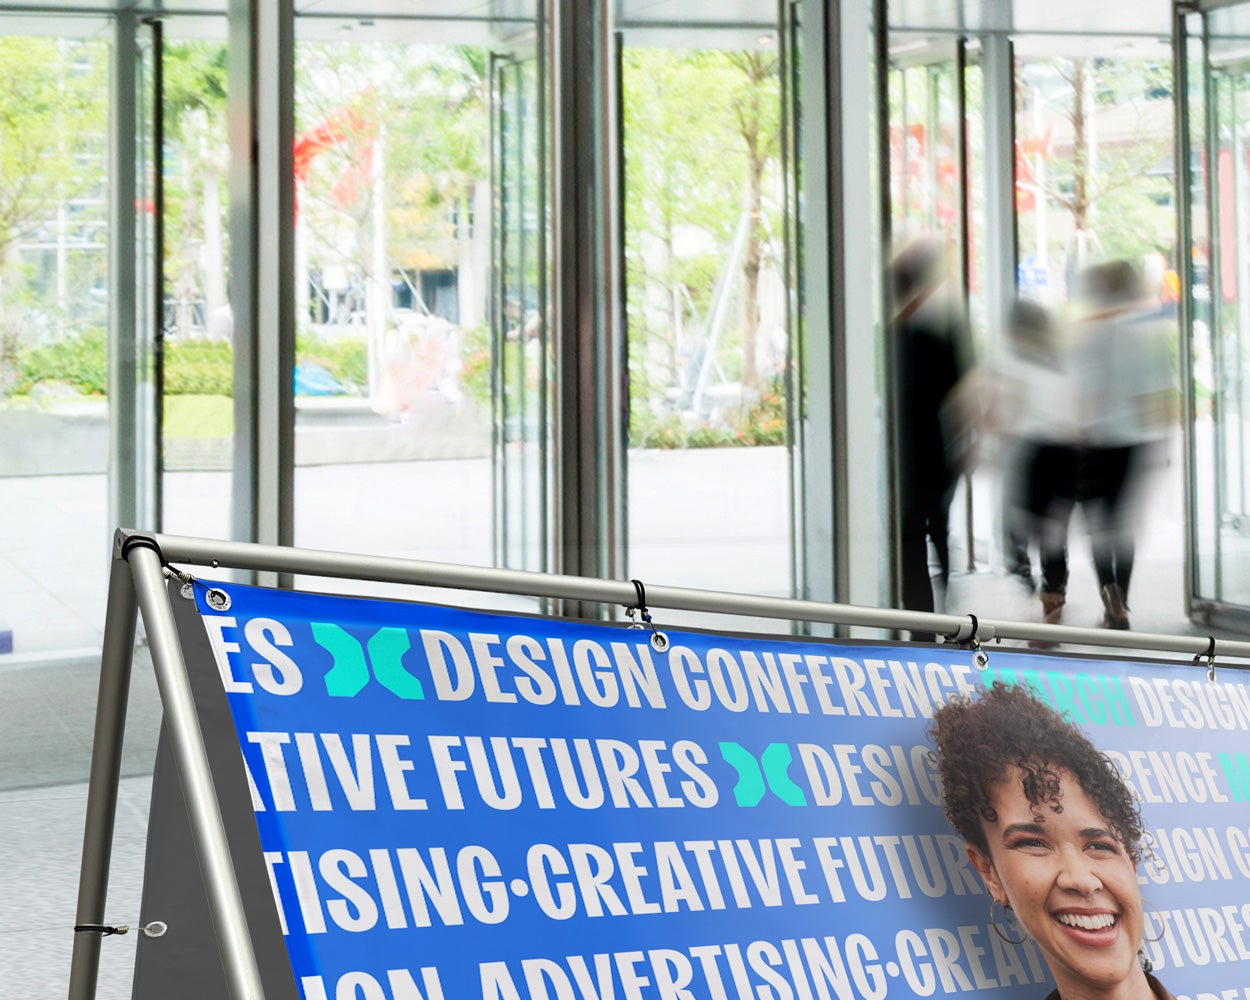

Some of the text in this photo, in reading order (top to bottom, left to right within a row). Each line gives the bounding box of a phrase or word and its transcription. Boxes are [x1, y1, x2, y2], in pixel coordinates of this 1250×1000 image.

[202, 614, 303, 696] ES
[420, 629, 667, 710] DESIGN
[980, 667, 1136, 727] ARCH
[241, 731, 426, 811] TIVE
[428, 735, 719, 809] FUTURES
[814, 834, 988, 904] FUTUR
[1137, 827, 1233, 886] SIGN
